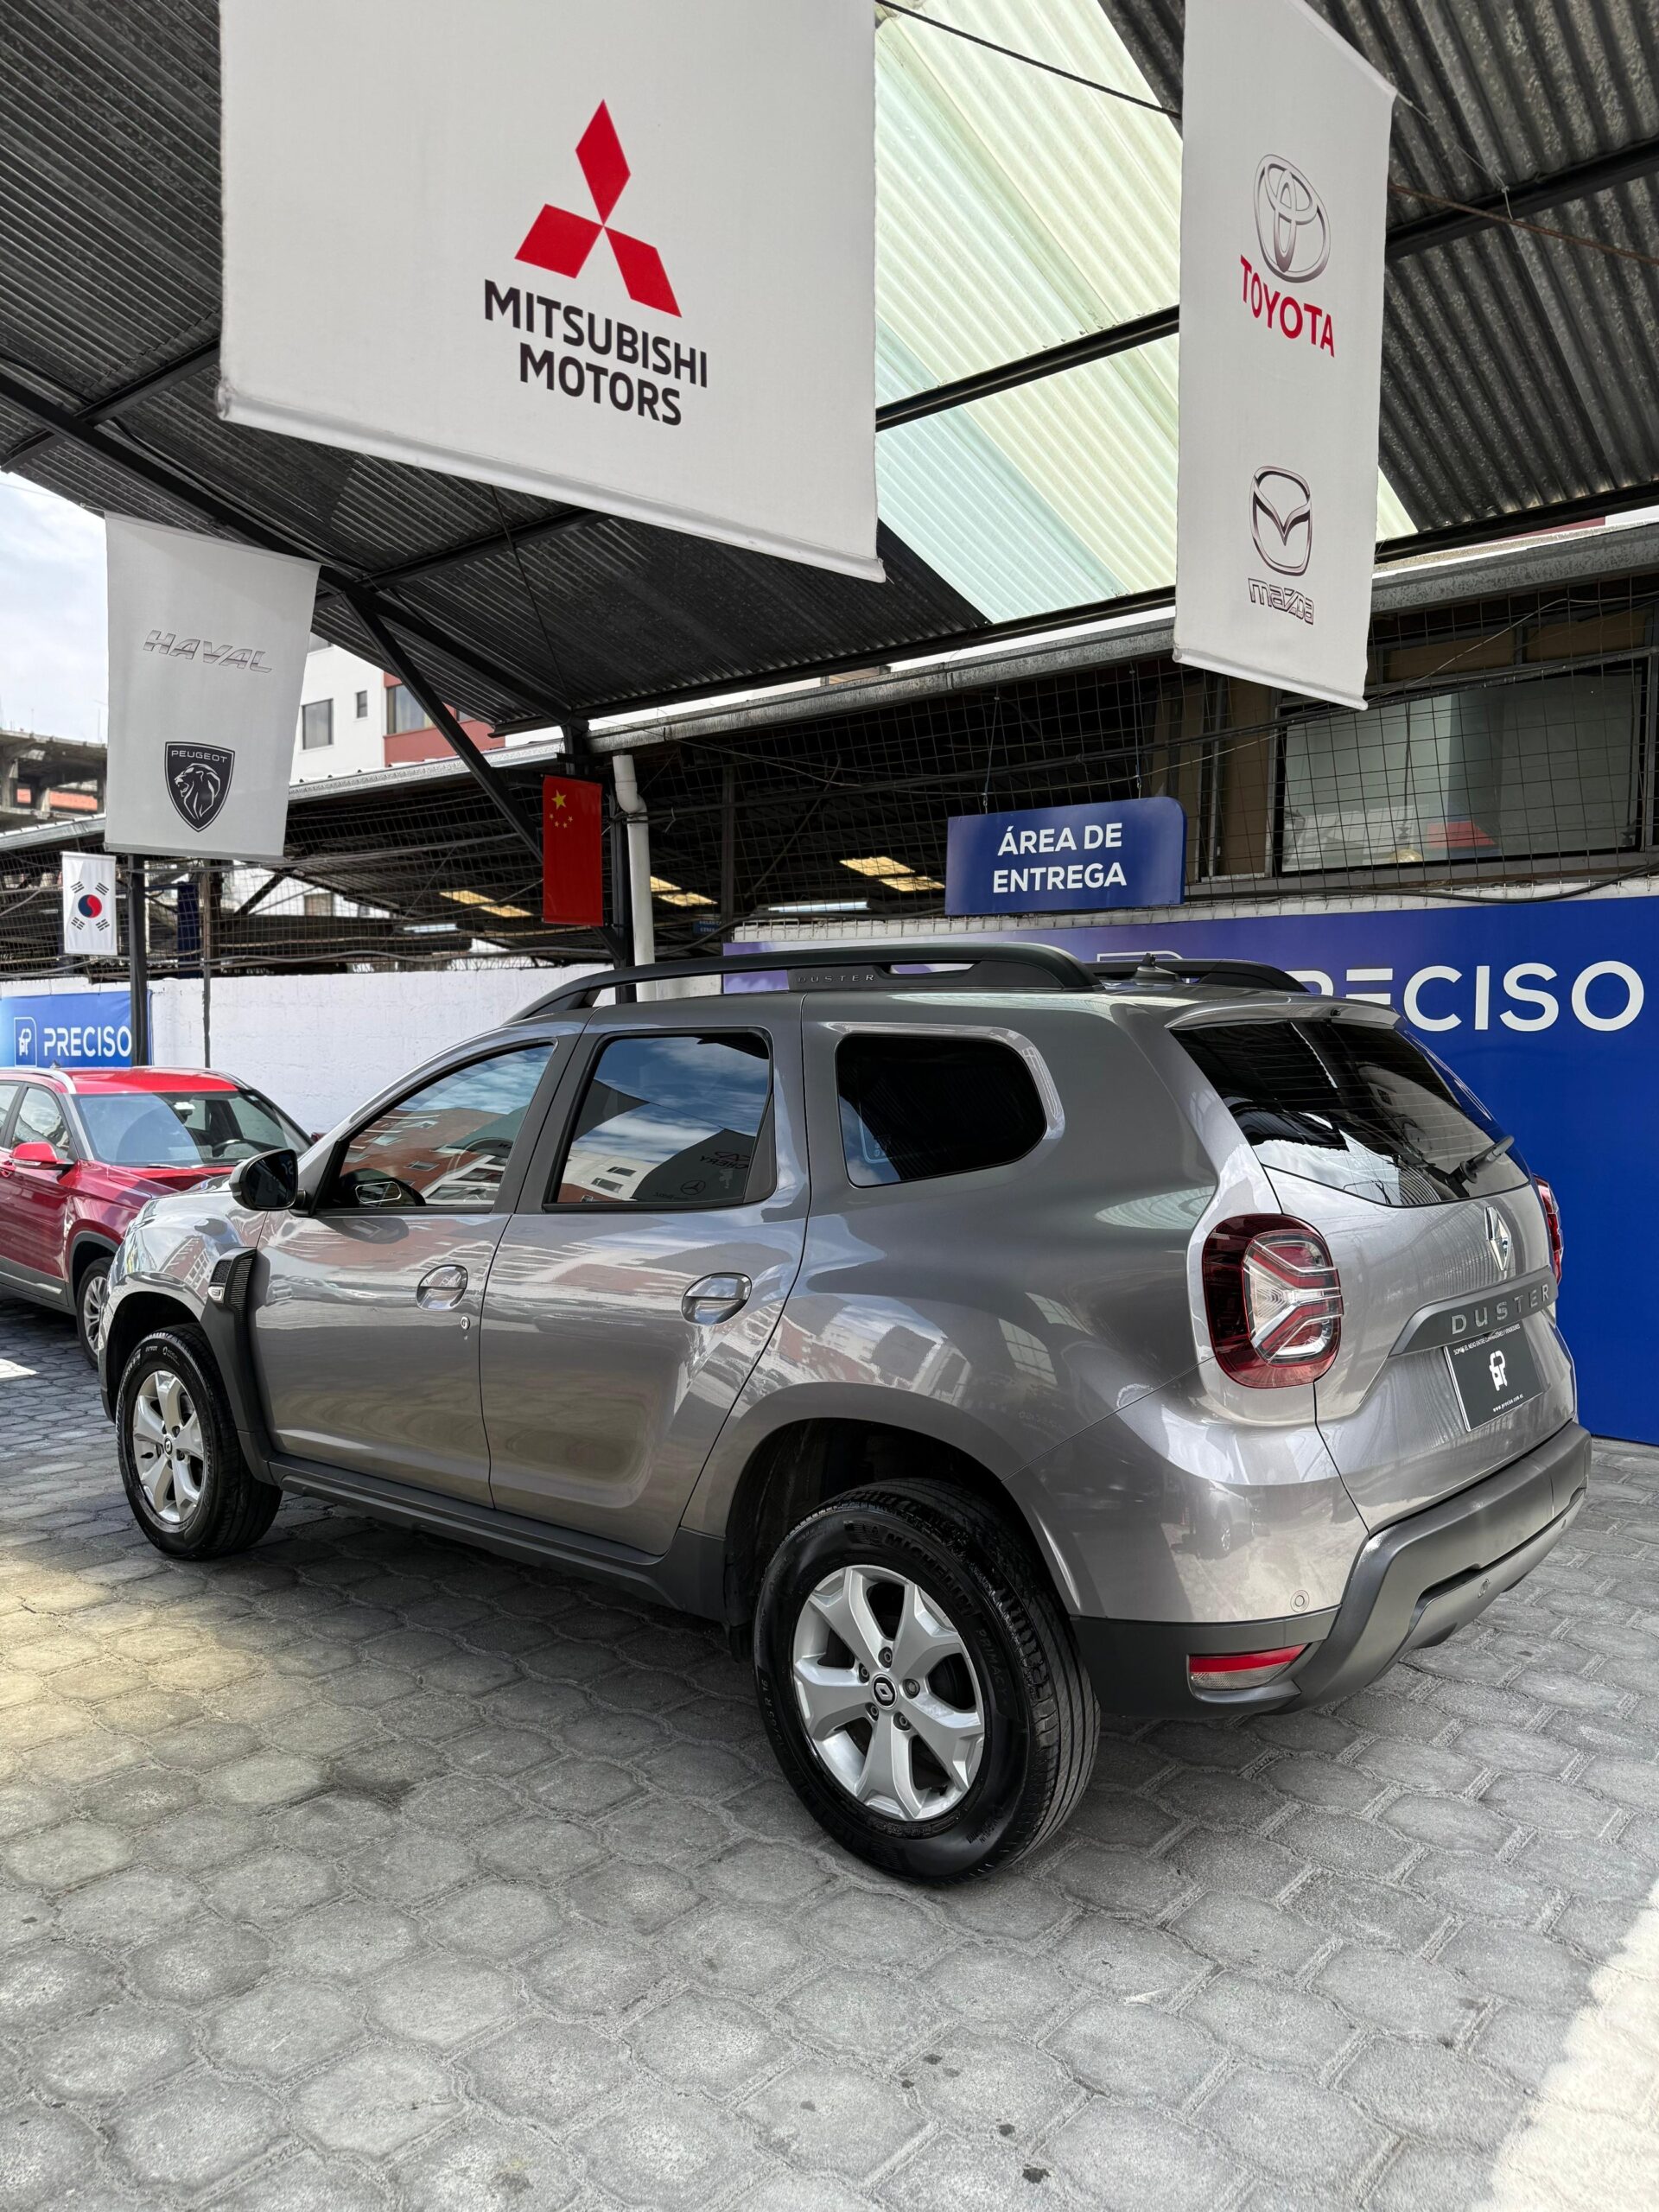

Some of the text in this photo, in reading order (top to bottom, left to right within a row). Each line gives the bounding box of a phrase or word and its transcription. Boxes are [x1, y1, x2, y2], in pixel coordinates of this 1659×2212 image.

[1240, 254, 1335, 358] TOYOTA
[485, 279, 707, 388] MITSUBISHI
[520, 342, 681, 426] MOTORS
[143, 630, 272, 673] HAVAL
[171, 750, 228, 763] PEUGEOT
[997, 823, 1122, 856] ÁREA DE
[993, 861, 1127, 893] ENTREGA
[798, 974, 874, 982] DUSTER
[44, 1027, 132, 1058] PRECISO
[1452, 1283, 1549, 1335] DUSTER
